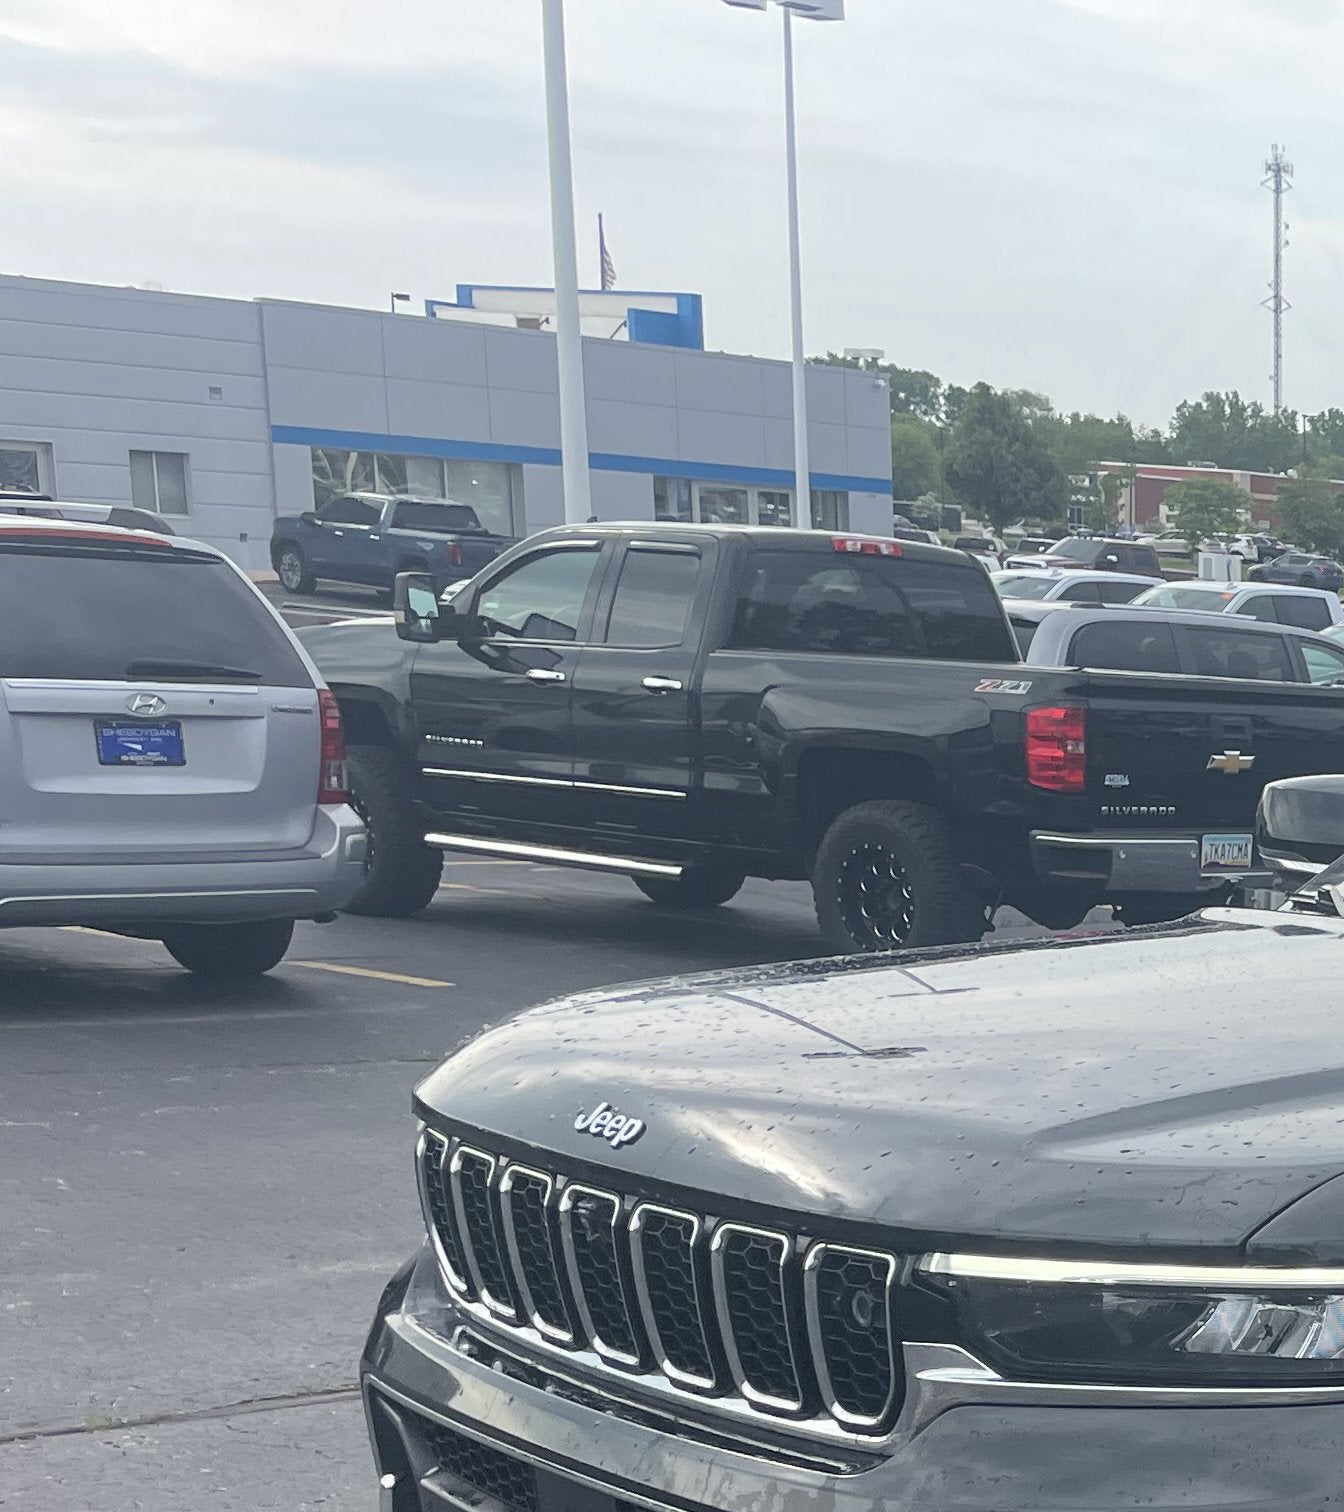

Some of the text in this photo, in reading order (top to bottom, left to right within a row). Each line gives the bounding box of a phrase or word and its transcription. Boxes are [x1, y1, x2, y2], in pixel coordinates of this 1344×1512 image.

[974, 678, 1033, 695] Z71
[102, 728, 176, 737] SHEBOYGAN
[1101, 806, 1176, 816] SILVERADO
[574, 1101, 644, 1148] Jeep
